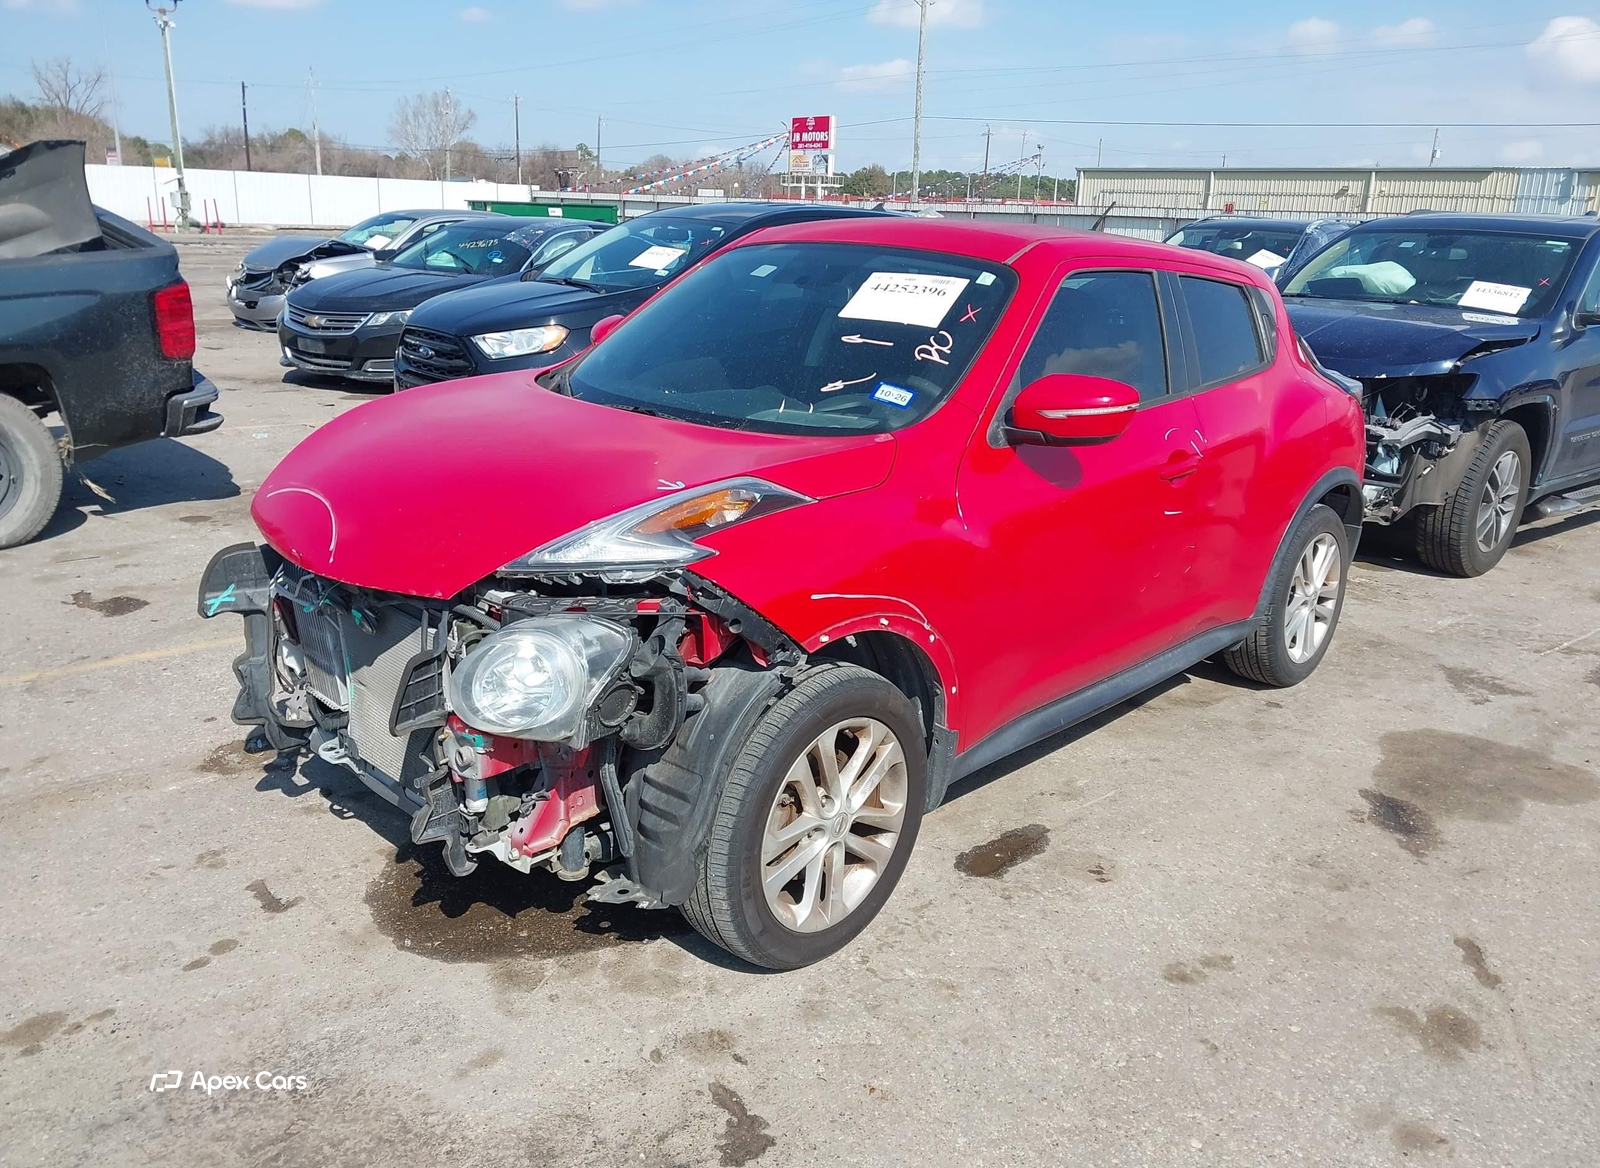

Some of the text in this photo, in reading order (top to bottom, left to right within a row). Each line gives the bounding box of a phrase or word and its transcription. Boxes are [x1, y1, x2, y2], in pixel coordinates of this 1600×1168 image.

[793, 131, 829, 142] JB MOTORS
[870, 283, 947, 297] 44252396
